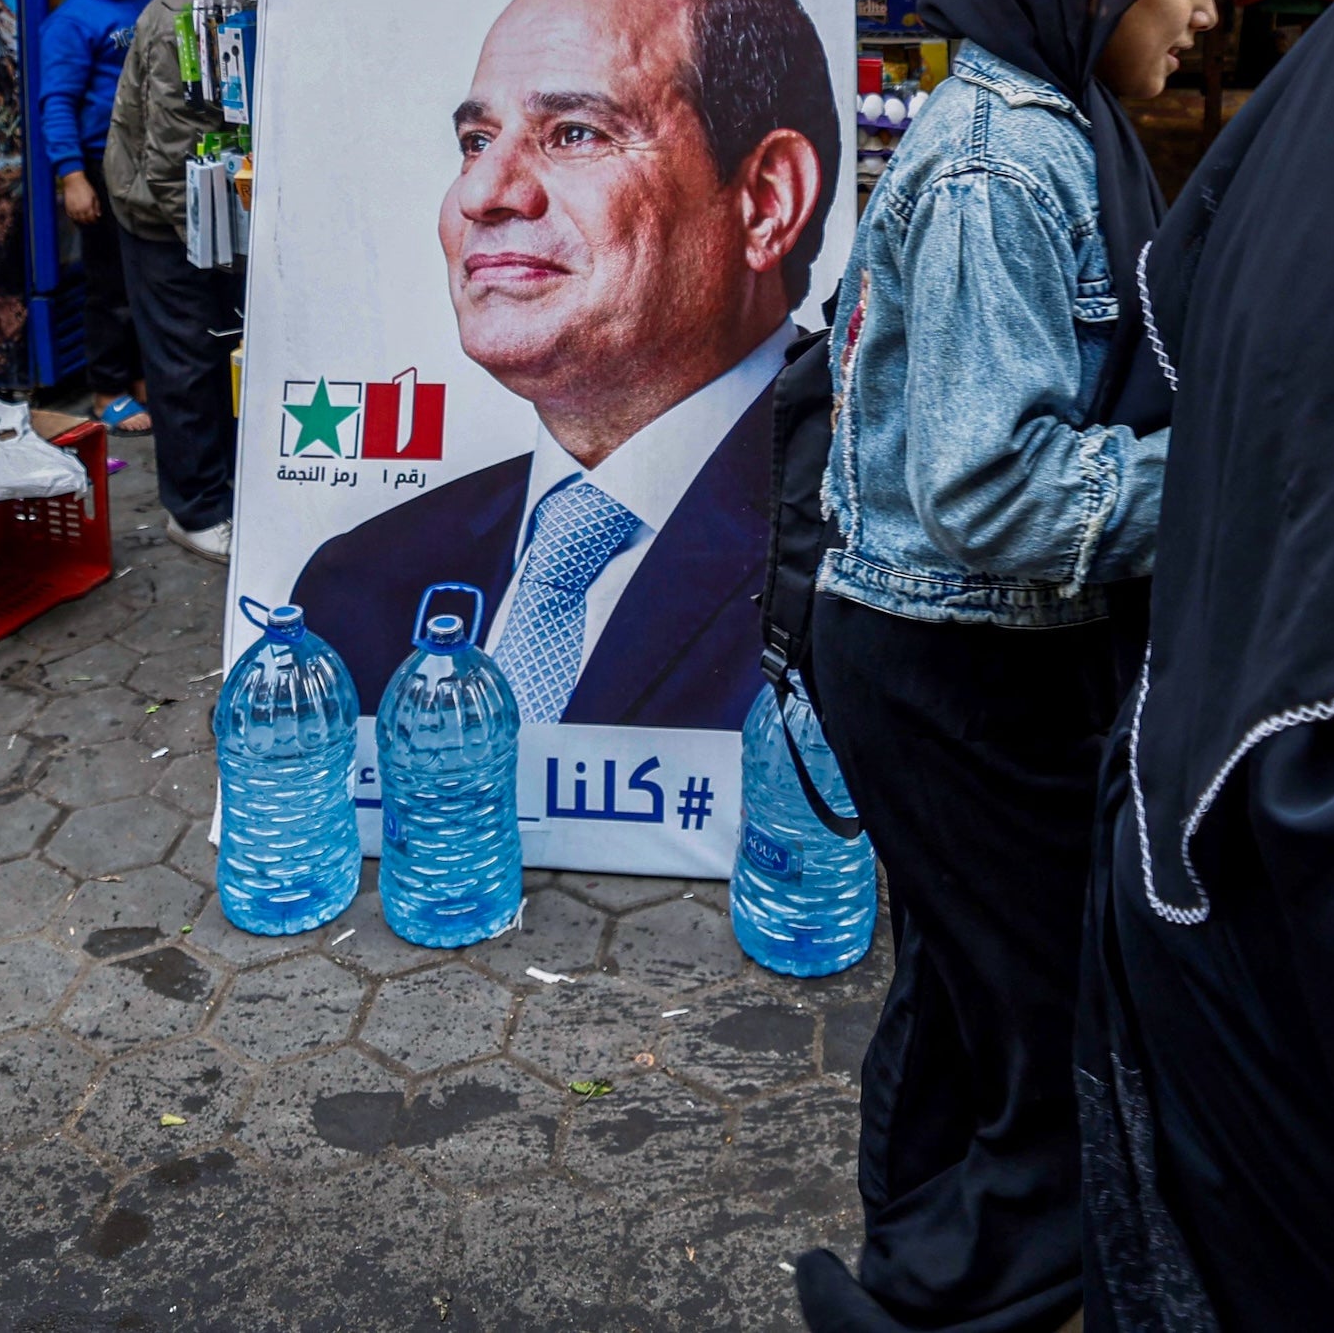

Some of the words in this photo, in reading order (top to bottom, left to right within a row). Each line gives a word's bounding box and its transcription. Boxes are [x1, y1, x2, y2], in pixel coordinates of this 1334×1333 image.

[276, 465, 326, 486] النجمة
[330, 468, 358, 488] رمز
[393, 469, 427, 490] رقم
